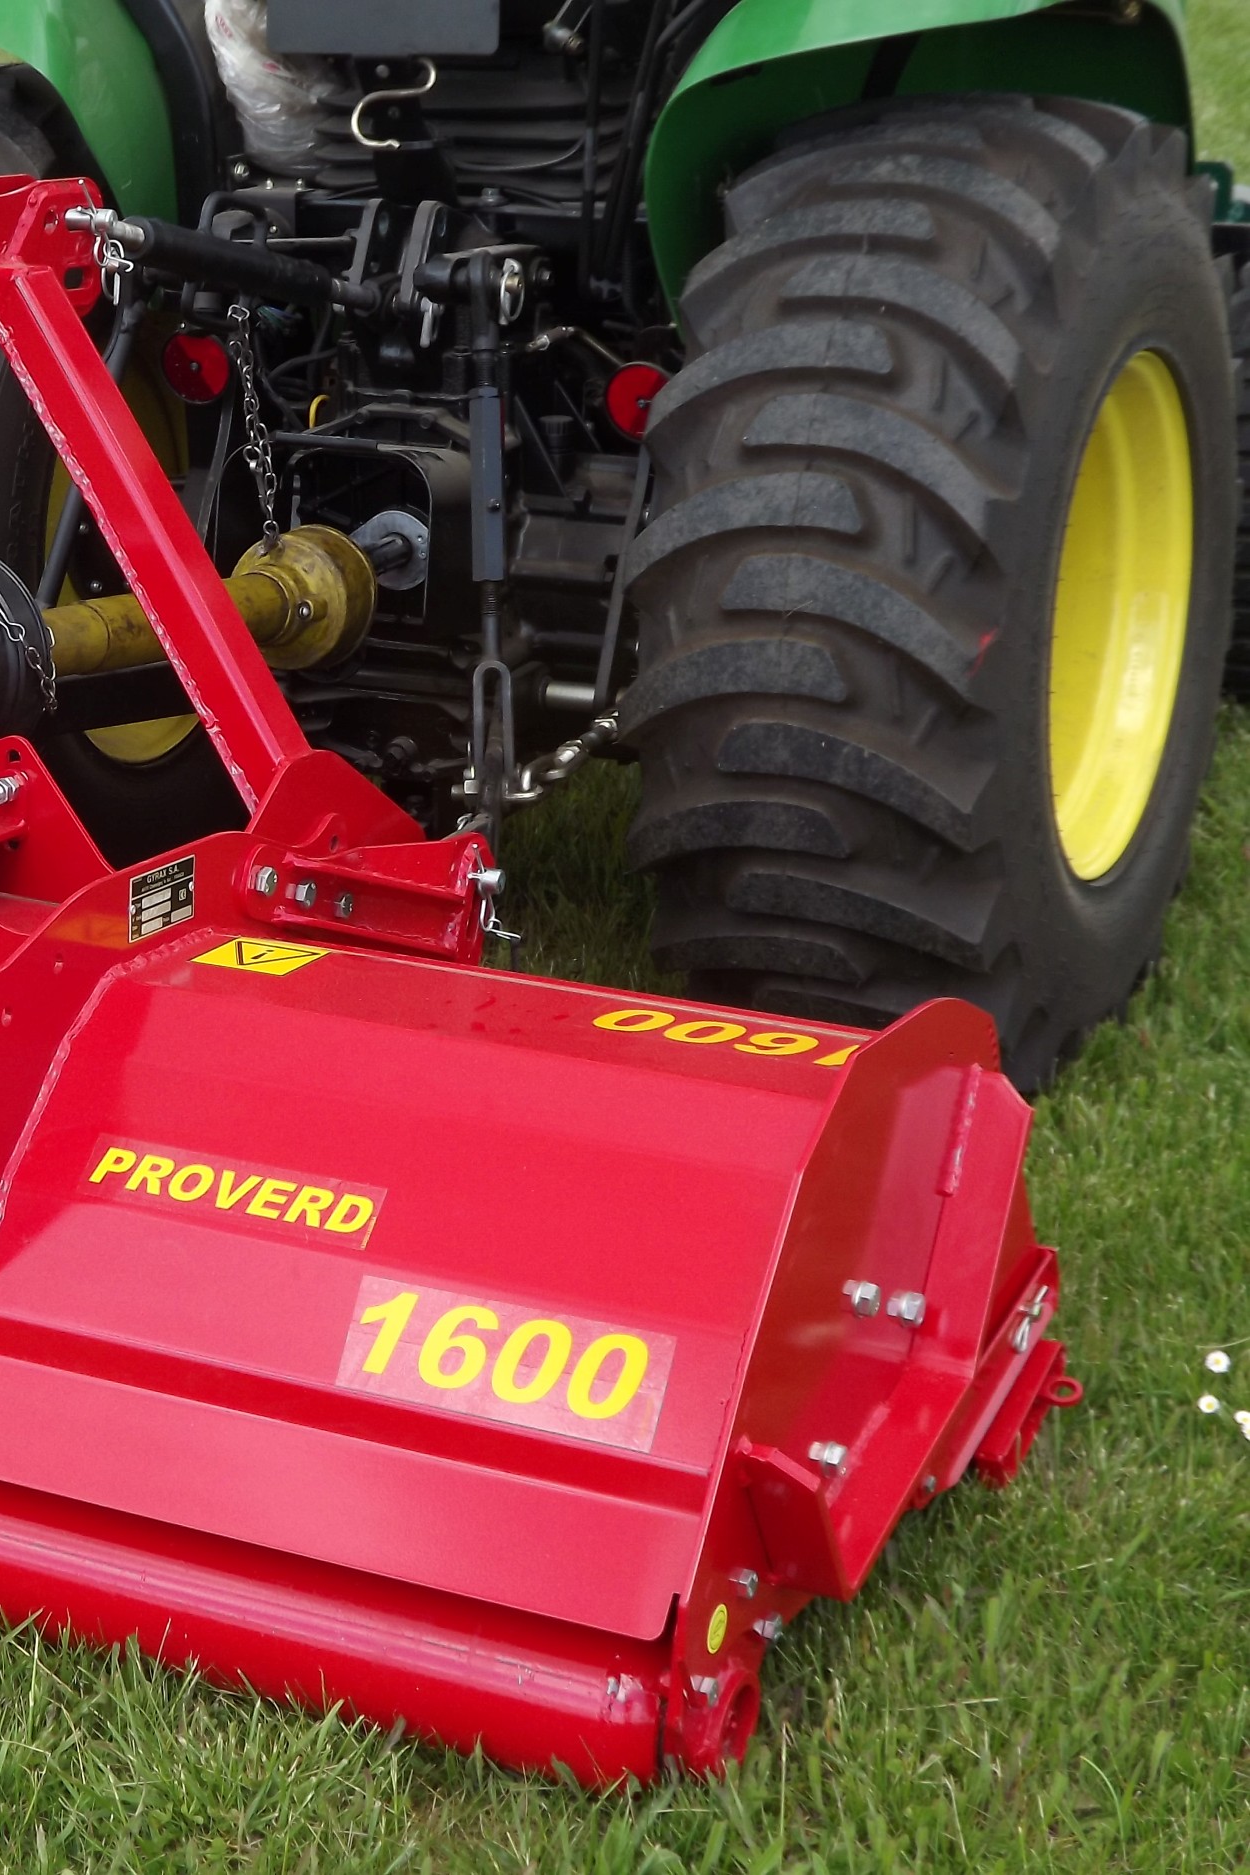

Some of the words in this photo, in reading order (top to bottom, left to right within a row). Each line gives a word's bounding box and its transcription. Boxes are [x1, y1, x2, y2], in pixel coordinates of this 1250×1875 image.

[146, 869, 167, 884] GYRAX
[90, 1148, 374, 1232] PROVERD
[359, 1291, 650, 1420] 1600
